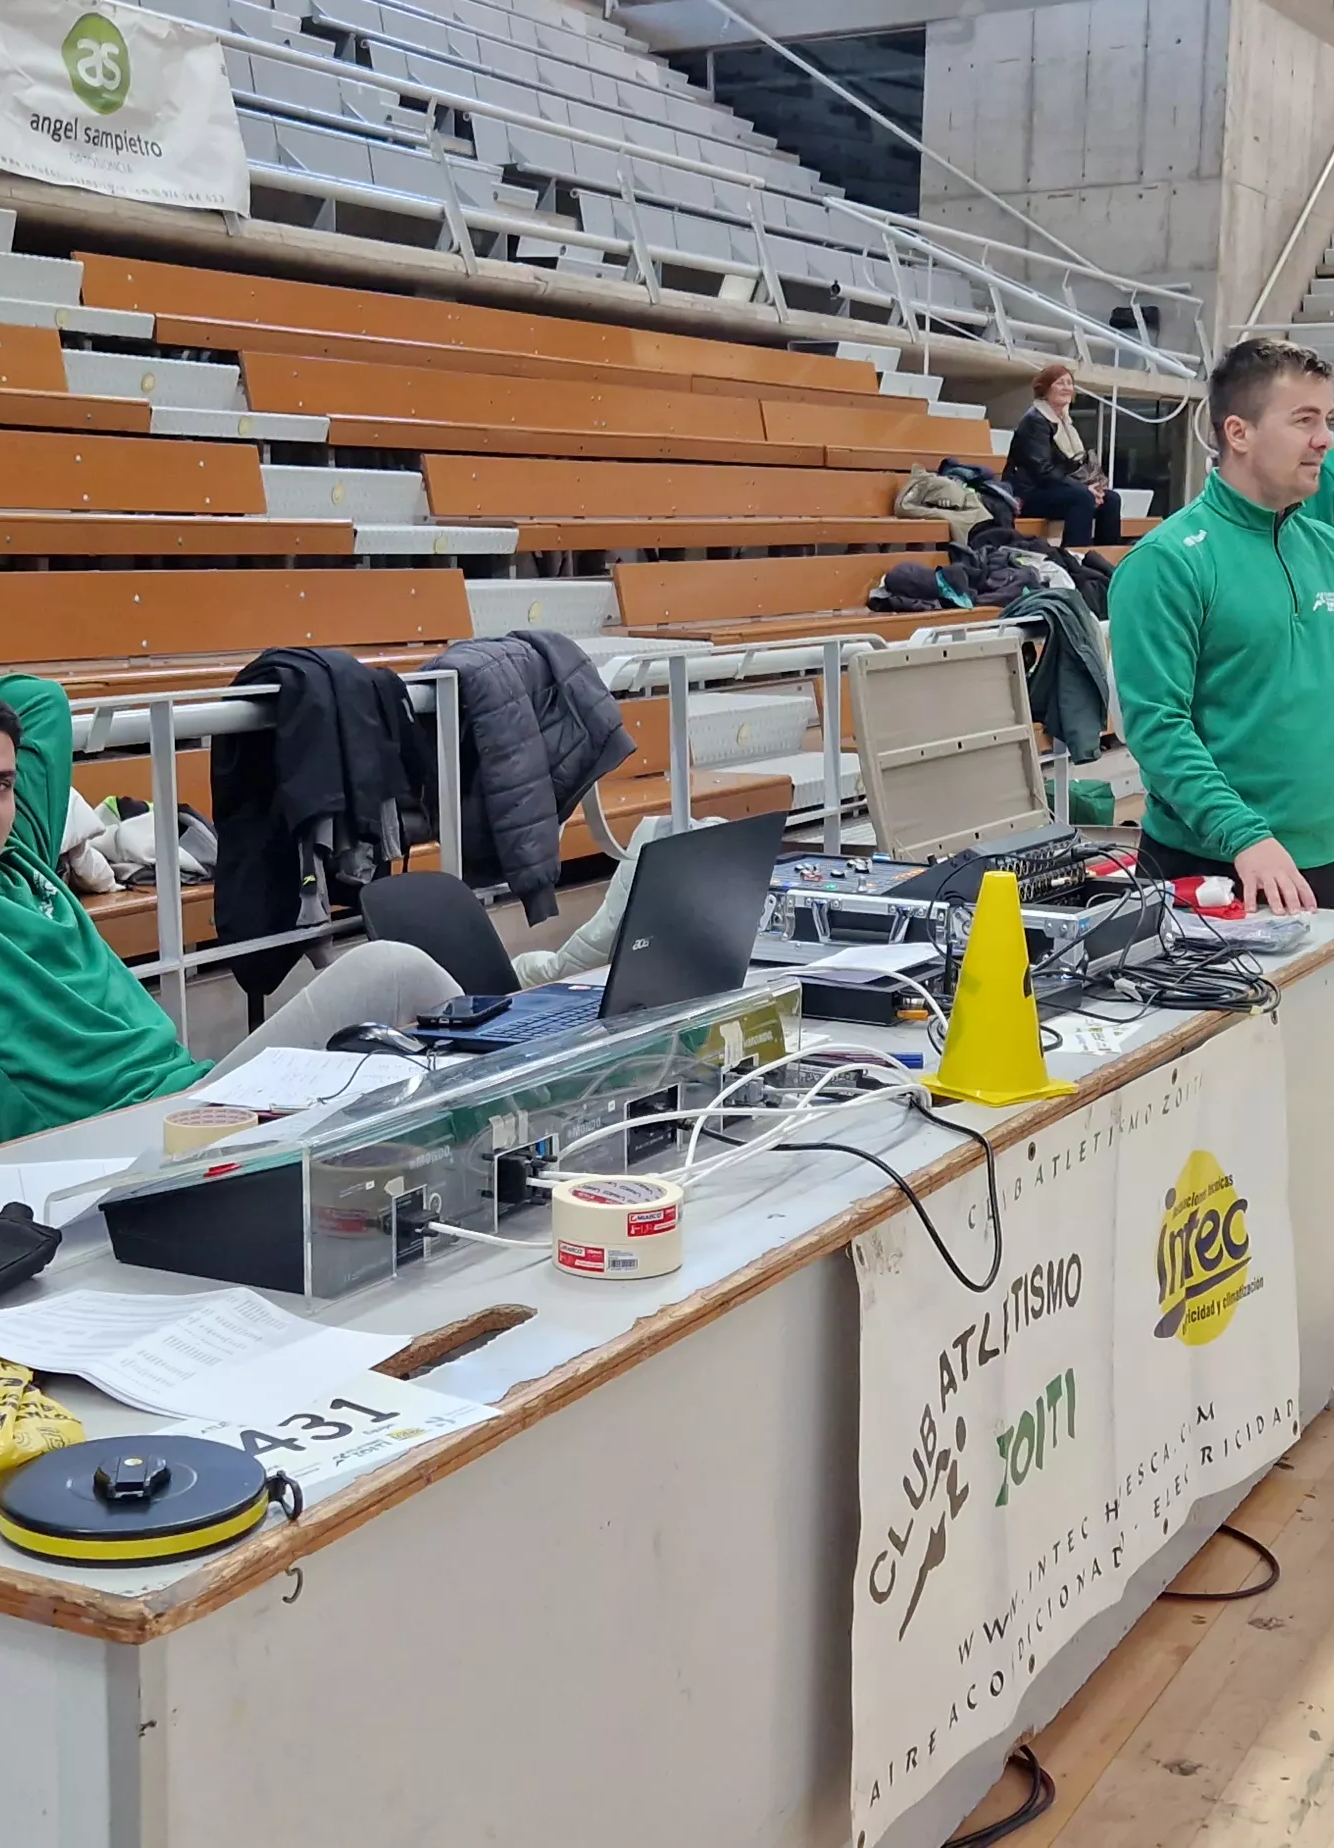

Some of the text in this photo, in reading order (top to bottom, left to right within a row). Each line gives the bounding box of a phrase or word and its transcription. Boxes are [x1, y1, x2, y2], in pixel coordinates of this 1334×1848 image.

[30, 111, 163, 157] angel sampietro
[239, 1397, 401, 1456] 431
[869, 1403, 938, 1605] CLUB
[870, 1727, 937, 1809] AIRE
